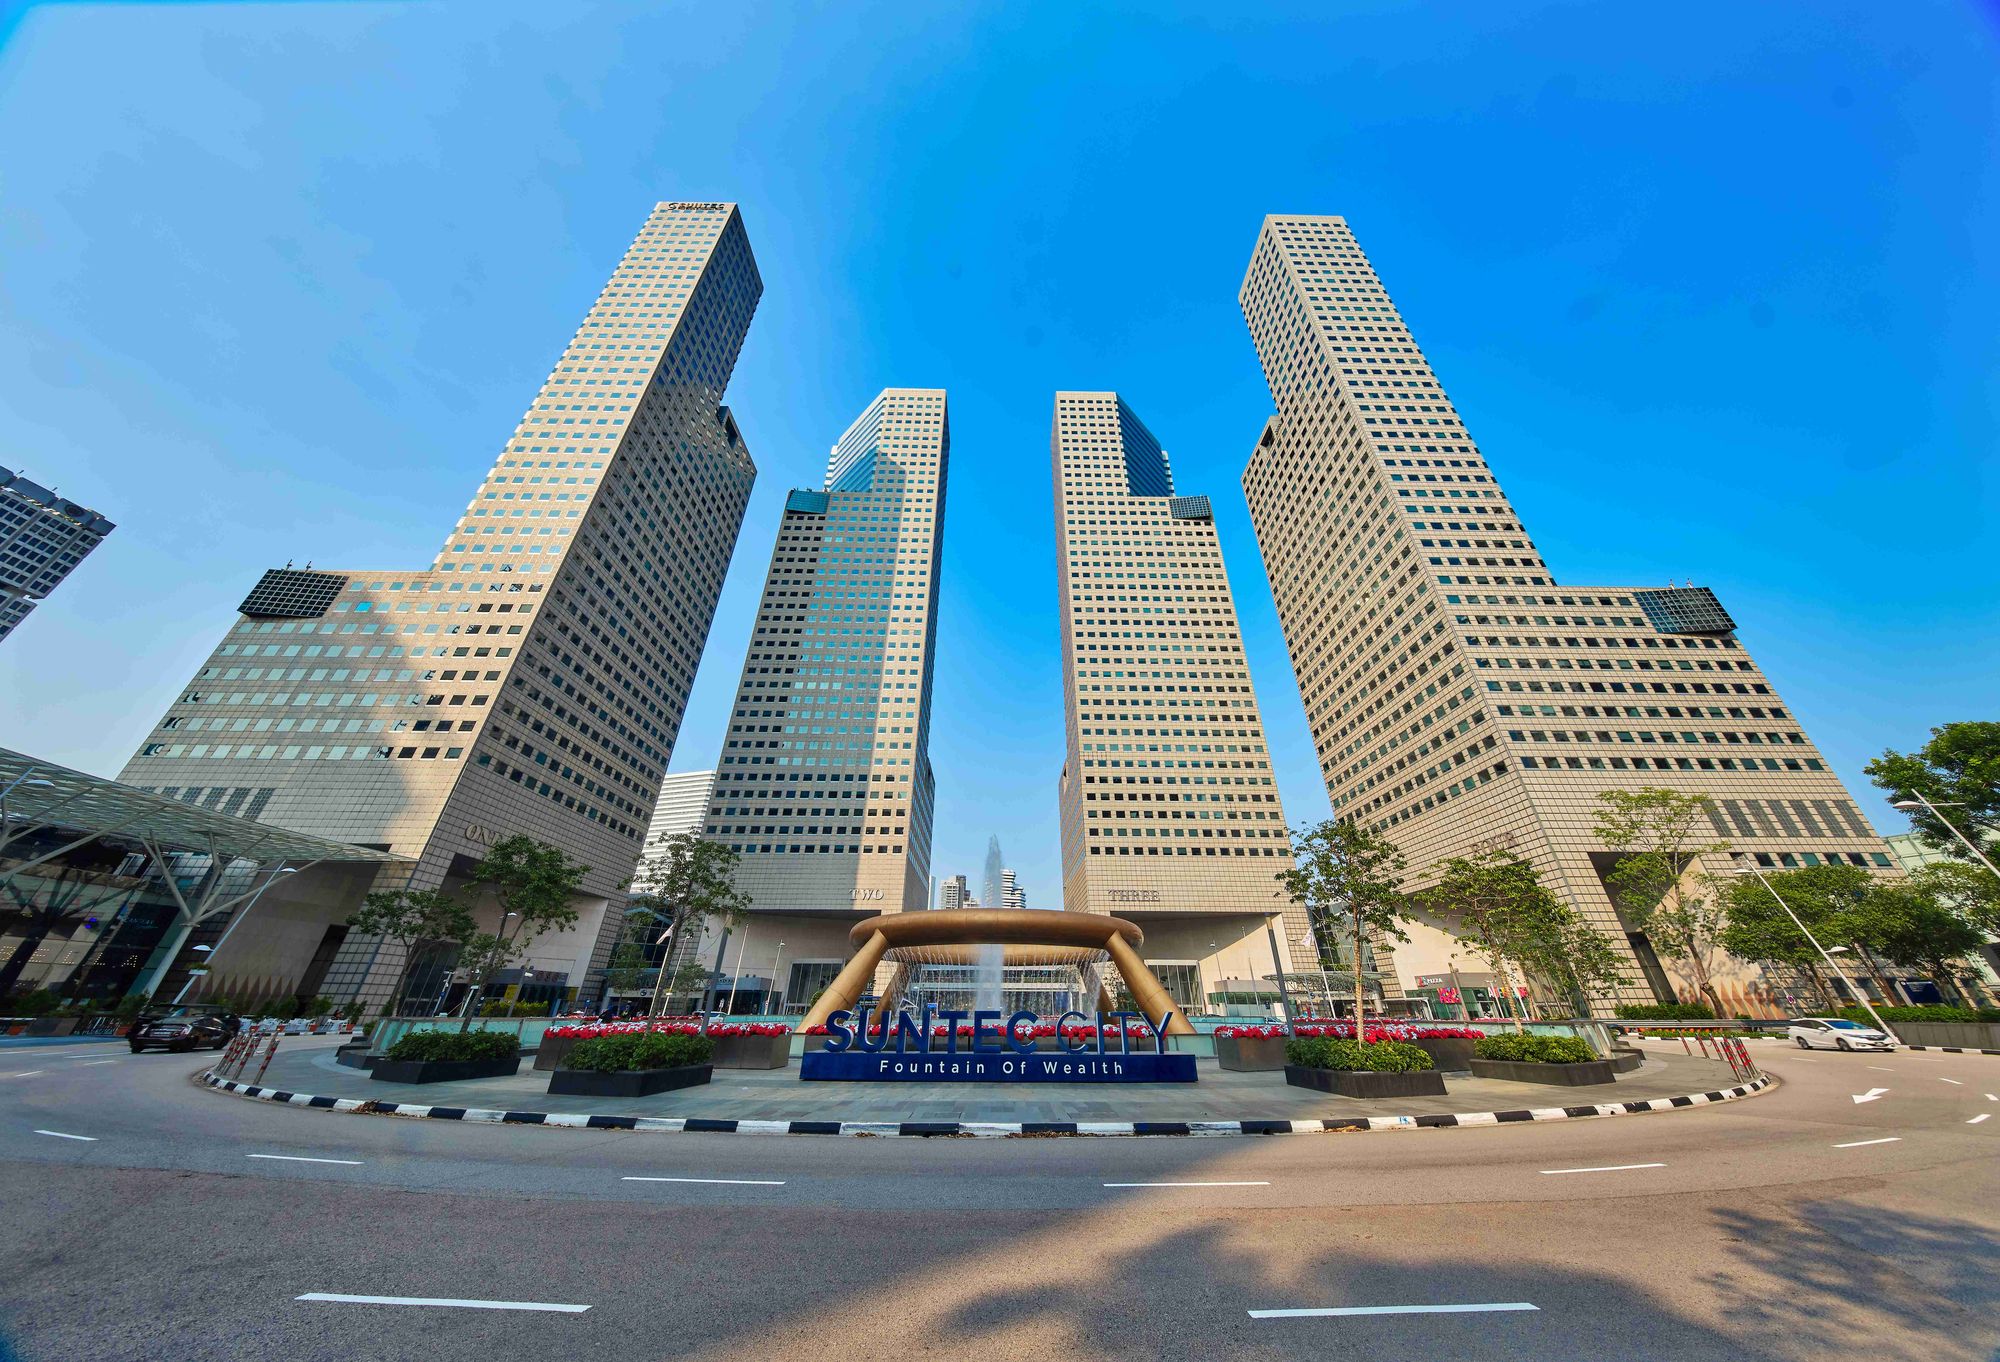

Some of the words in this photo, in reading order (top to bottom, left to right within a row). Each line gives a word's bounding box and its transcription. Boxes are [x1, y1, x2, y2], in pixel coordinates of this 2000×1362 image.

[848, 888, 884, 901] TWO
[1108, 889, 1160, 902] THREE
[823, 1010, 1039, 1054] SUNTEC
[1056, 1011, 1174, 1055] CITY
[880, 1060, 985, 1074] Fountain
[1003, 1061, 1026, 1074] Of
[1043, 1061, 1123, 1075] Wealth
